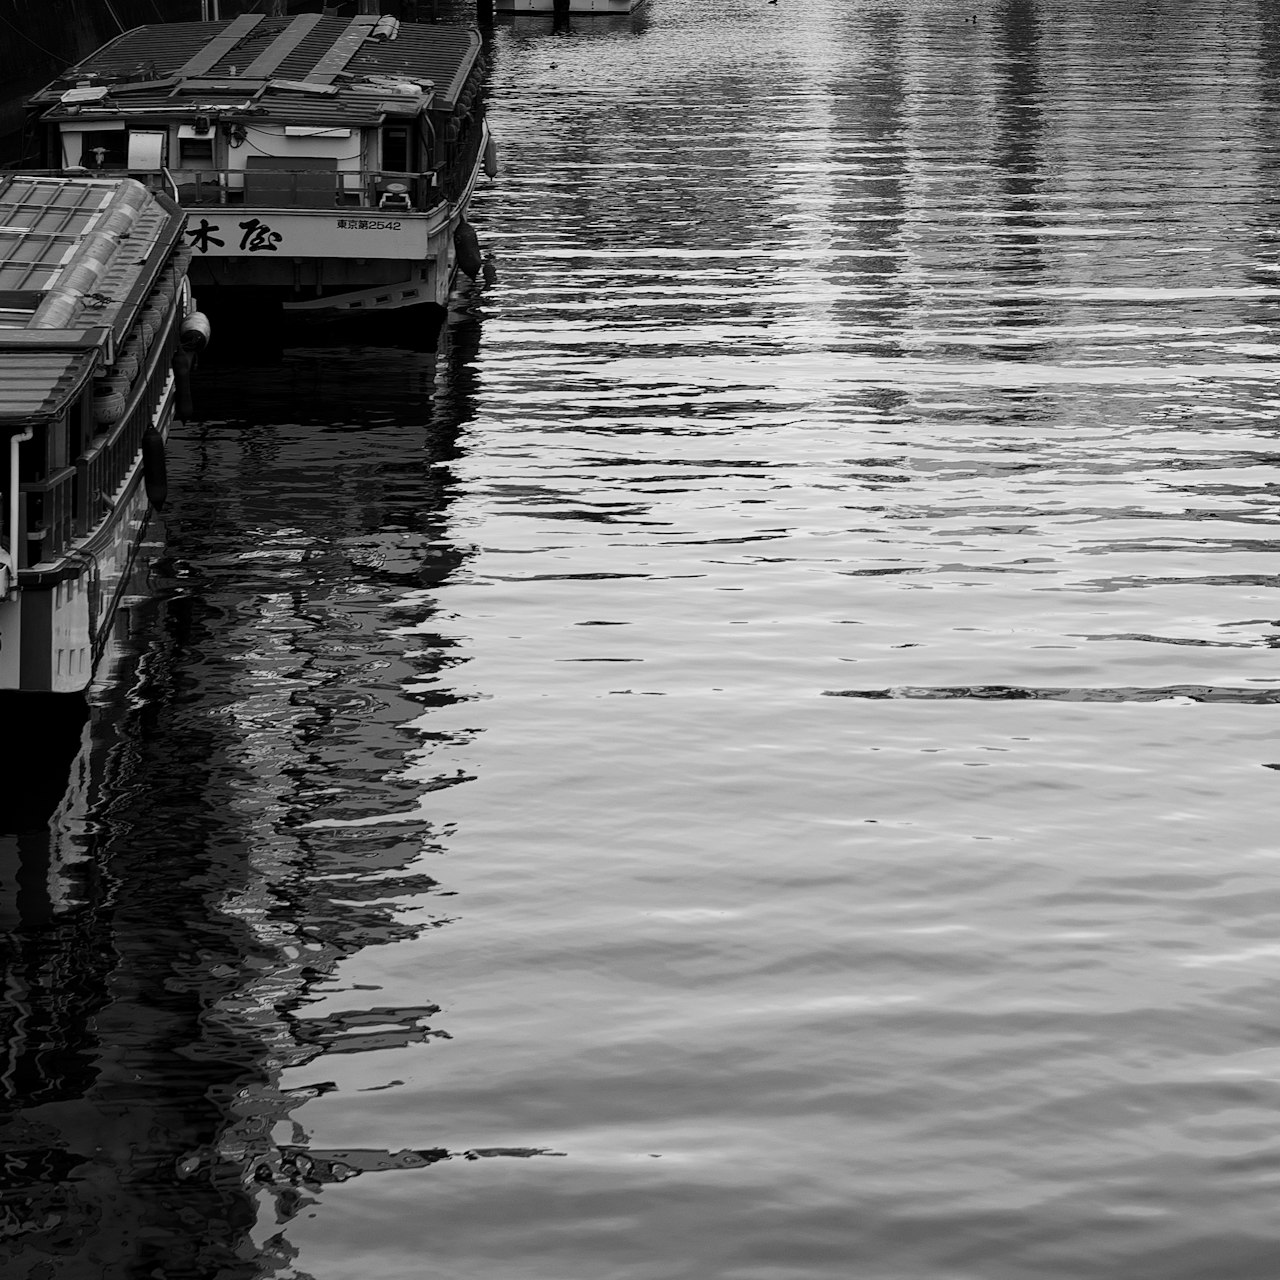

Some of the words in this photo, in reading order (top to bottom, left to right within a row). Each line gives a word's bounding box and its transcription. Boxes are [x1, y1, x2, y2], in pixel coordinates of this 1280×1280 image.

[185, 218, 283, 254] 木屋
[336, 219, 402, 231] 東京第2542
